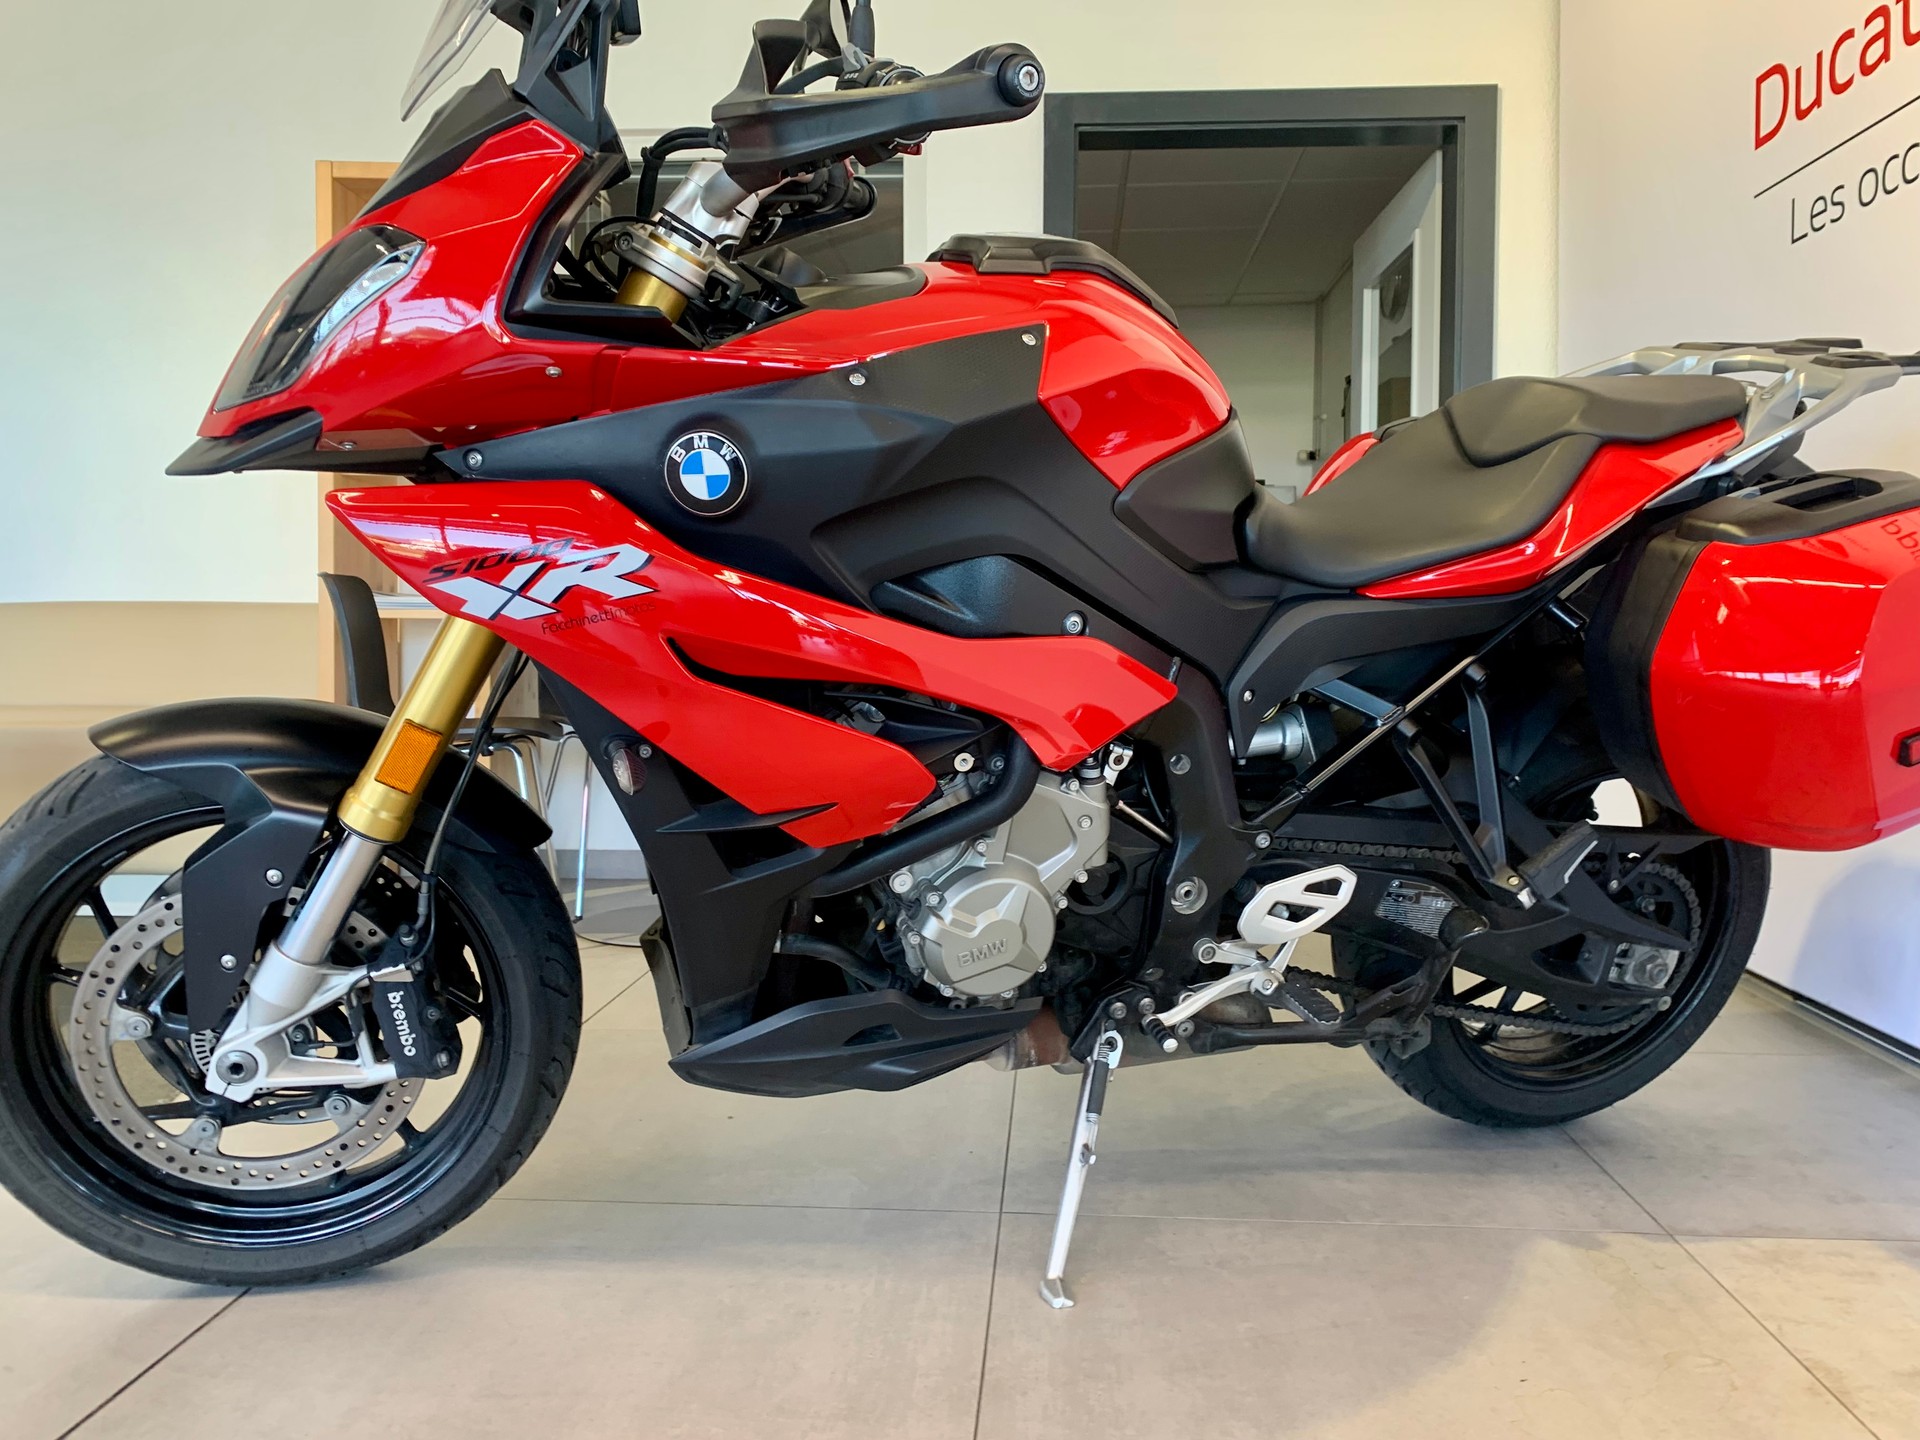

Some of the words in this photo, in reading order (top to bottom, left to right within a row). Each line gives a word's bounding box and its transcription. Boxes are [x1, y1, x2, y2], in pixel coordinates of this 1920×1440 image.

[1791, 182, 1845, 244] Les
[670, 434, 737, 463] BMW
[426, 543, 660, 620] XR
[958, 938, 1007, 967] BMW
[388, 991, 416, 1056] brembo
